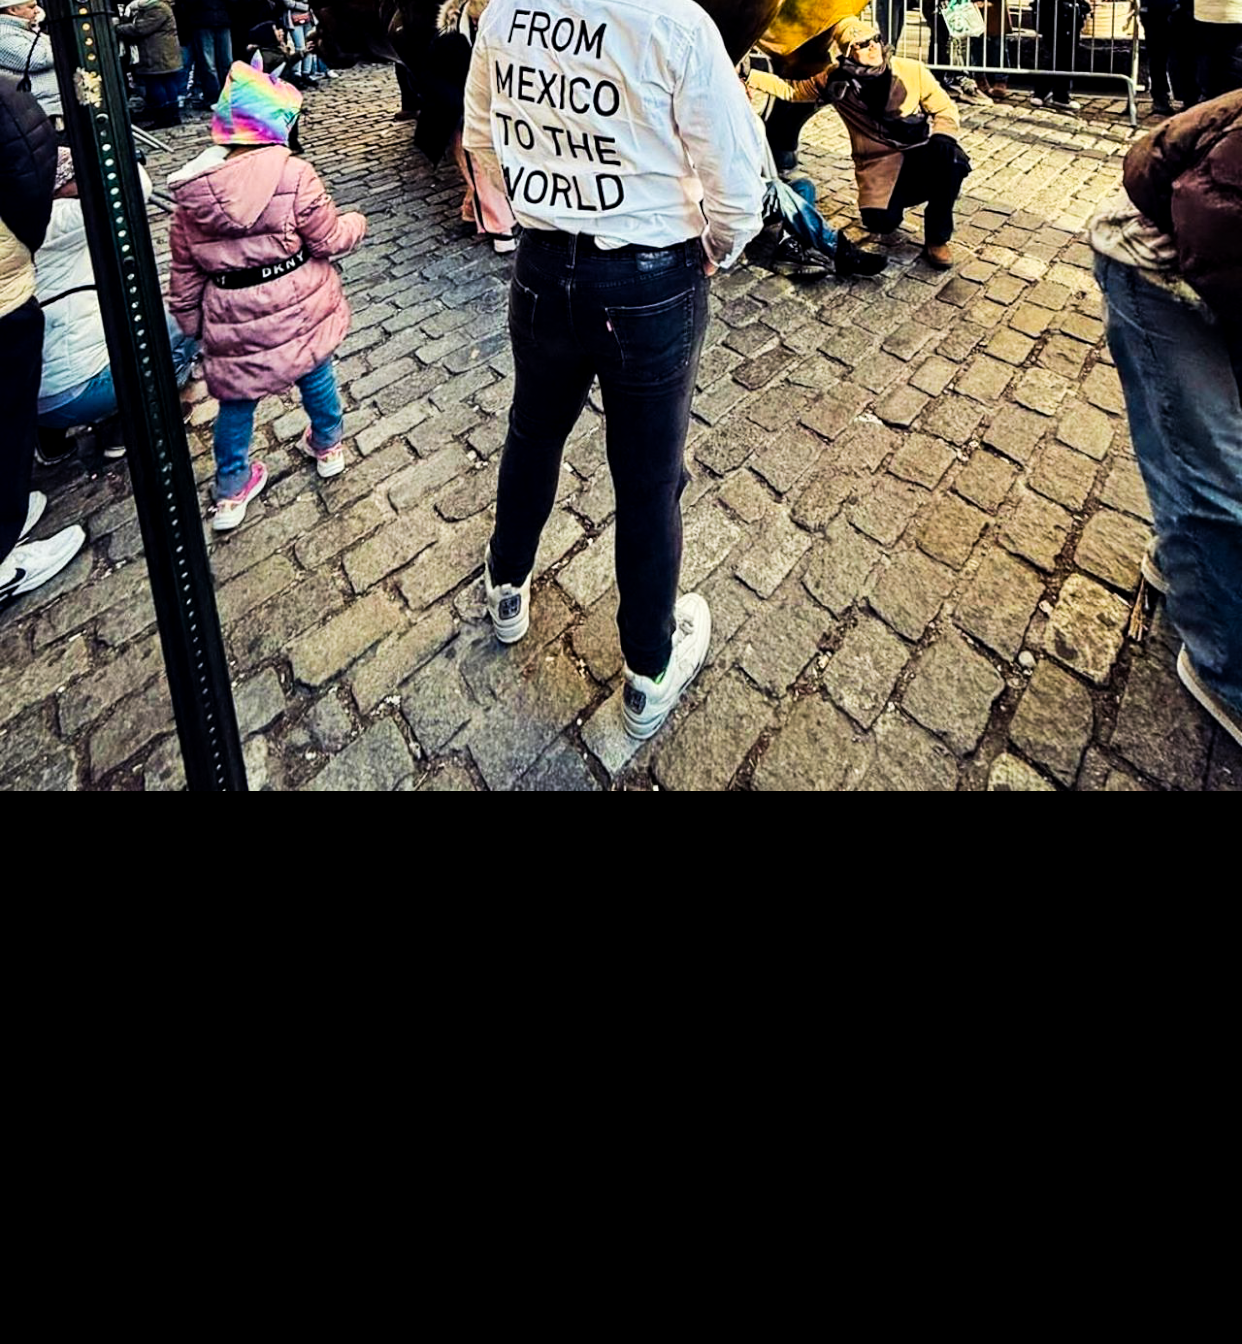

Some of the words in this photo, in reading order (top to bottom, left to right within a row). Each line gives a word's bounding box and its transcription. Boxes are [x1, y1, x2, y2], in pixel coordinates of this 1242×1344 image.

[507, 9, 607, 59] FROM
[495, 60, 620, 116] MEXICO
[495, 112, 535, 150] TO
[542, 125, 622, 167] THE
[261, 250, 304, 278] DKNY
